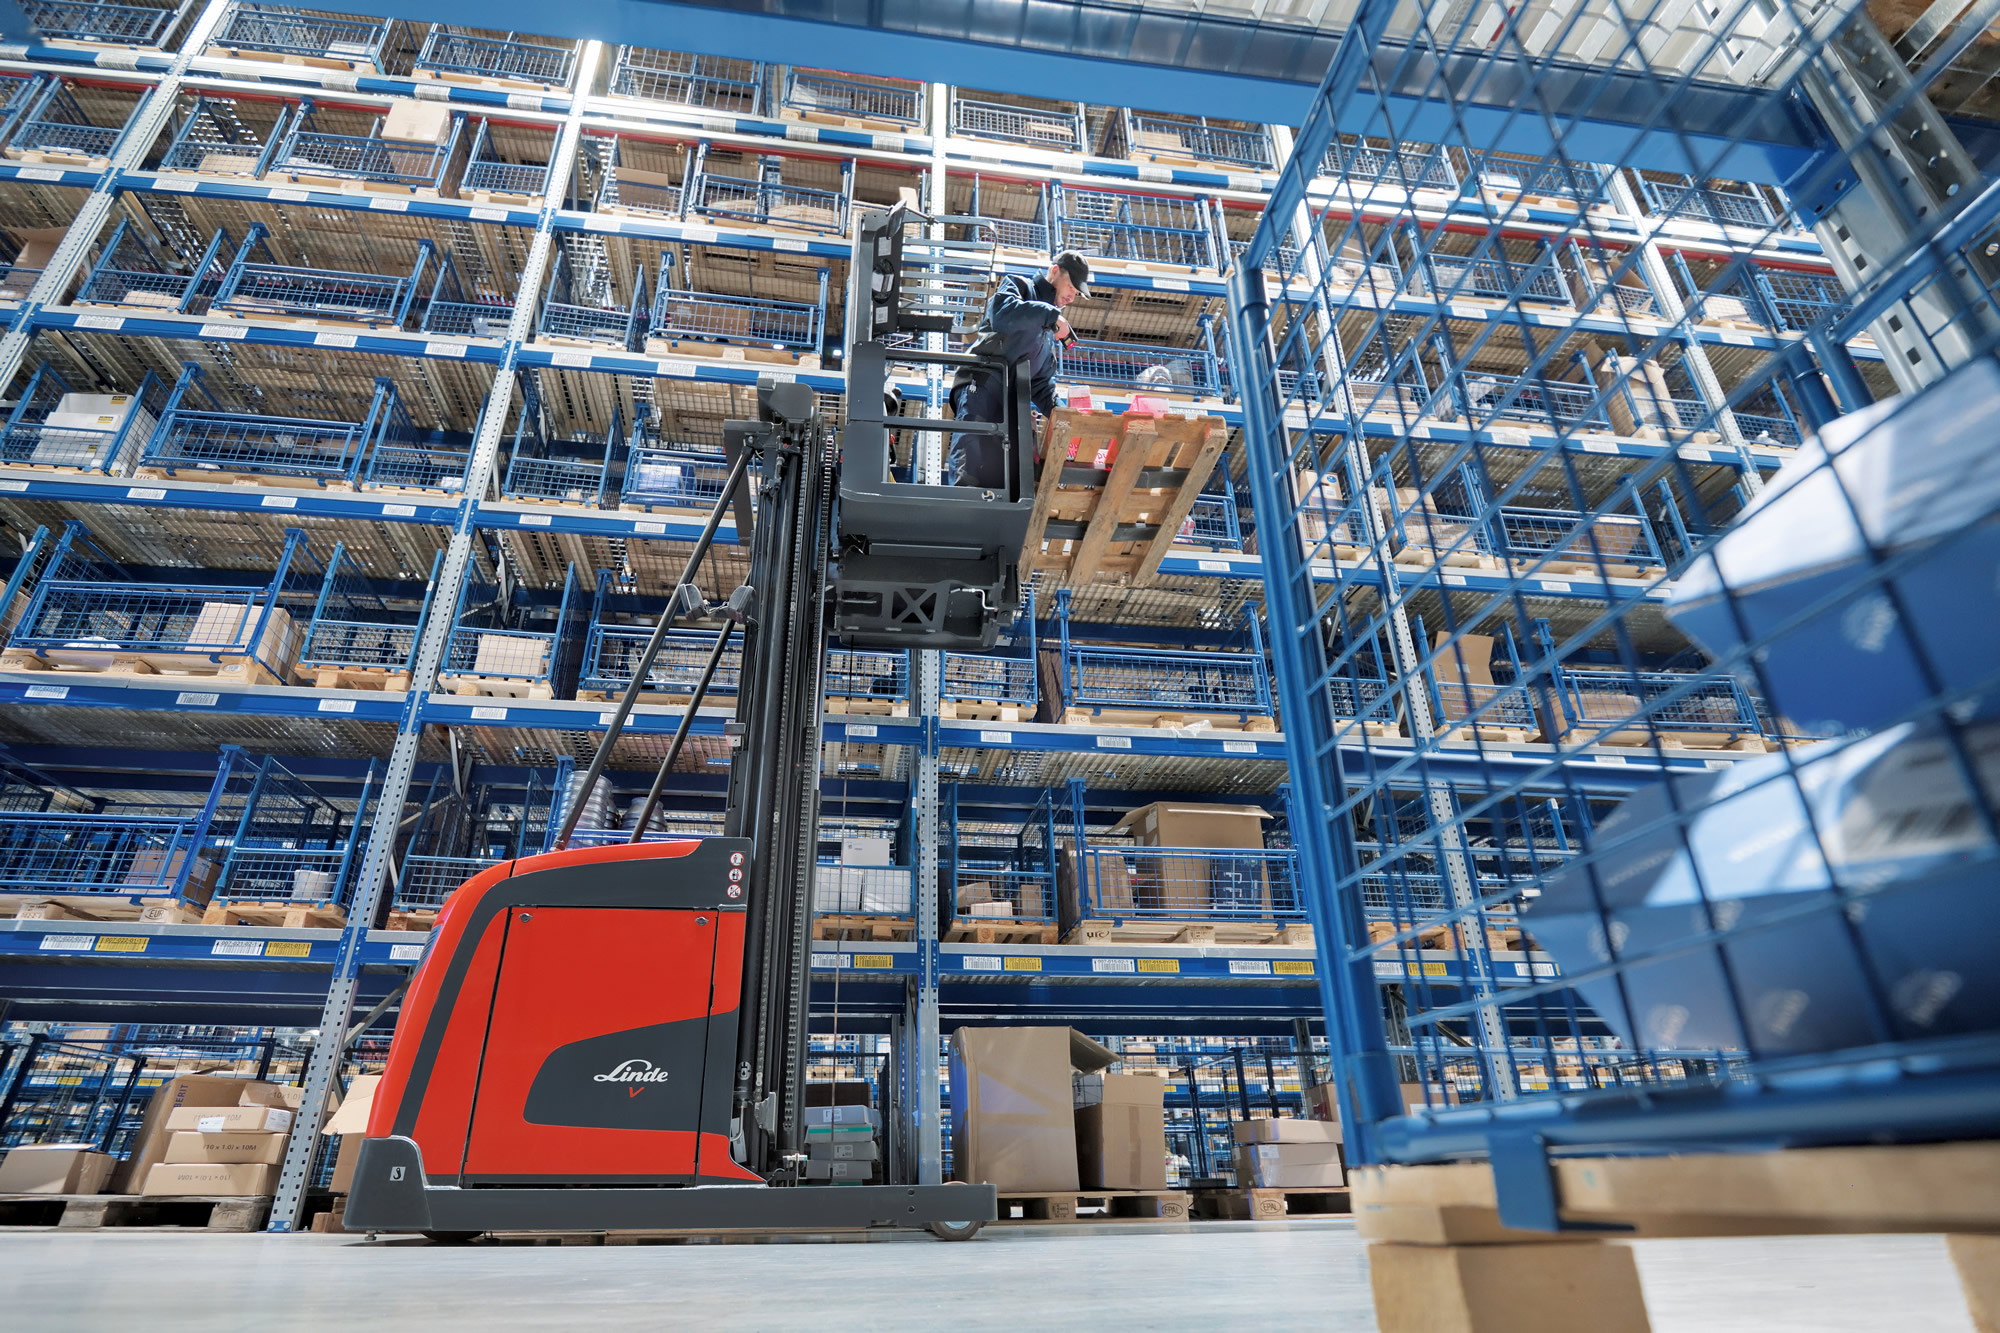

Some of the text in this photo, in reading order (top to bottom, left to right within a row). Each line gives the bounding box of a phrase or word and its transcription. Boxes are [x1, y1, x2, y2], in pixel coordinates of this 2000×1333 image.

[149, 909, 164, 918] EUR
[593, 1059, 668, 1083] Linde
[173, 1084, 189, 1108] BERIT
[1164, 1206, 1180, 1214] EPAL
[1262, 1202, 1278, 1211] EPAL
